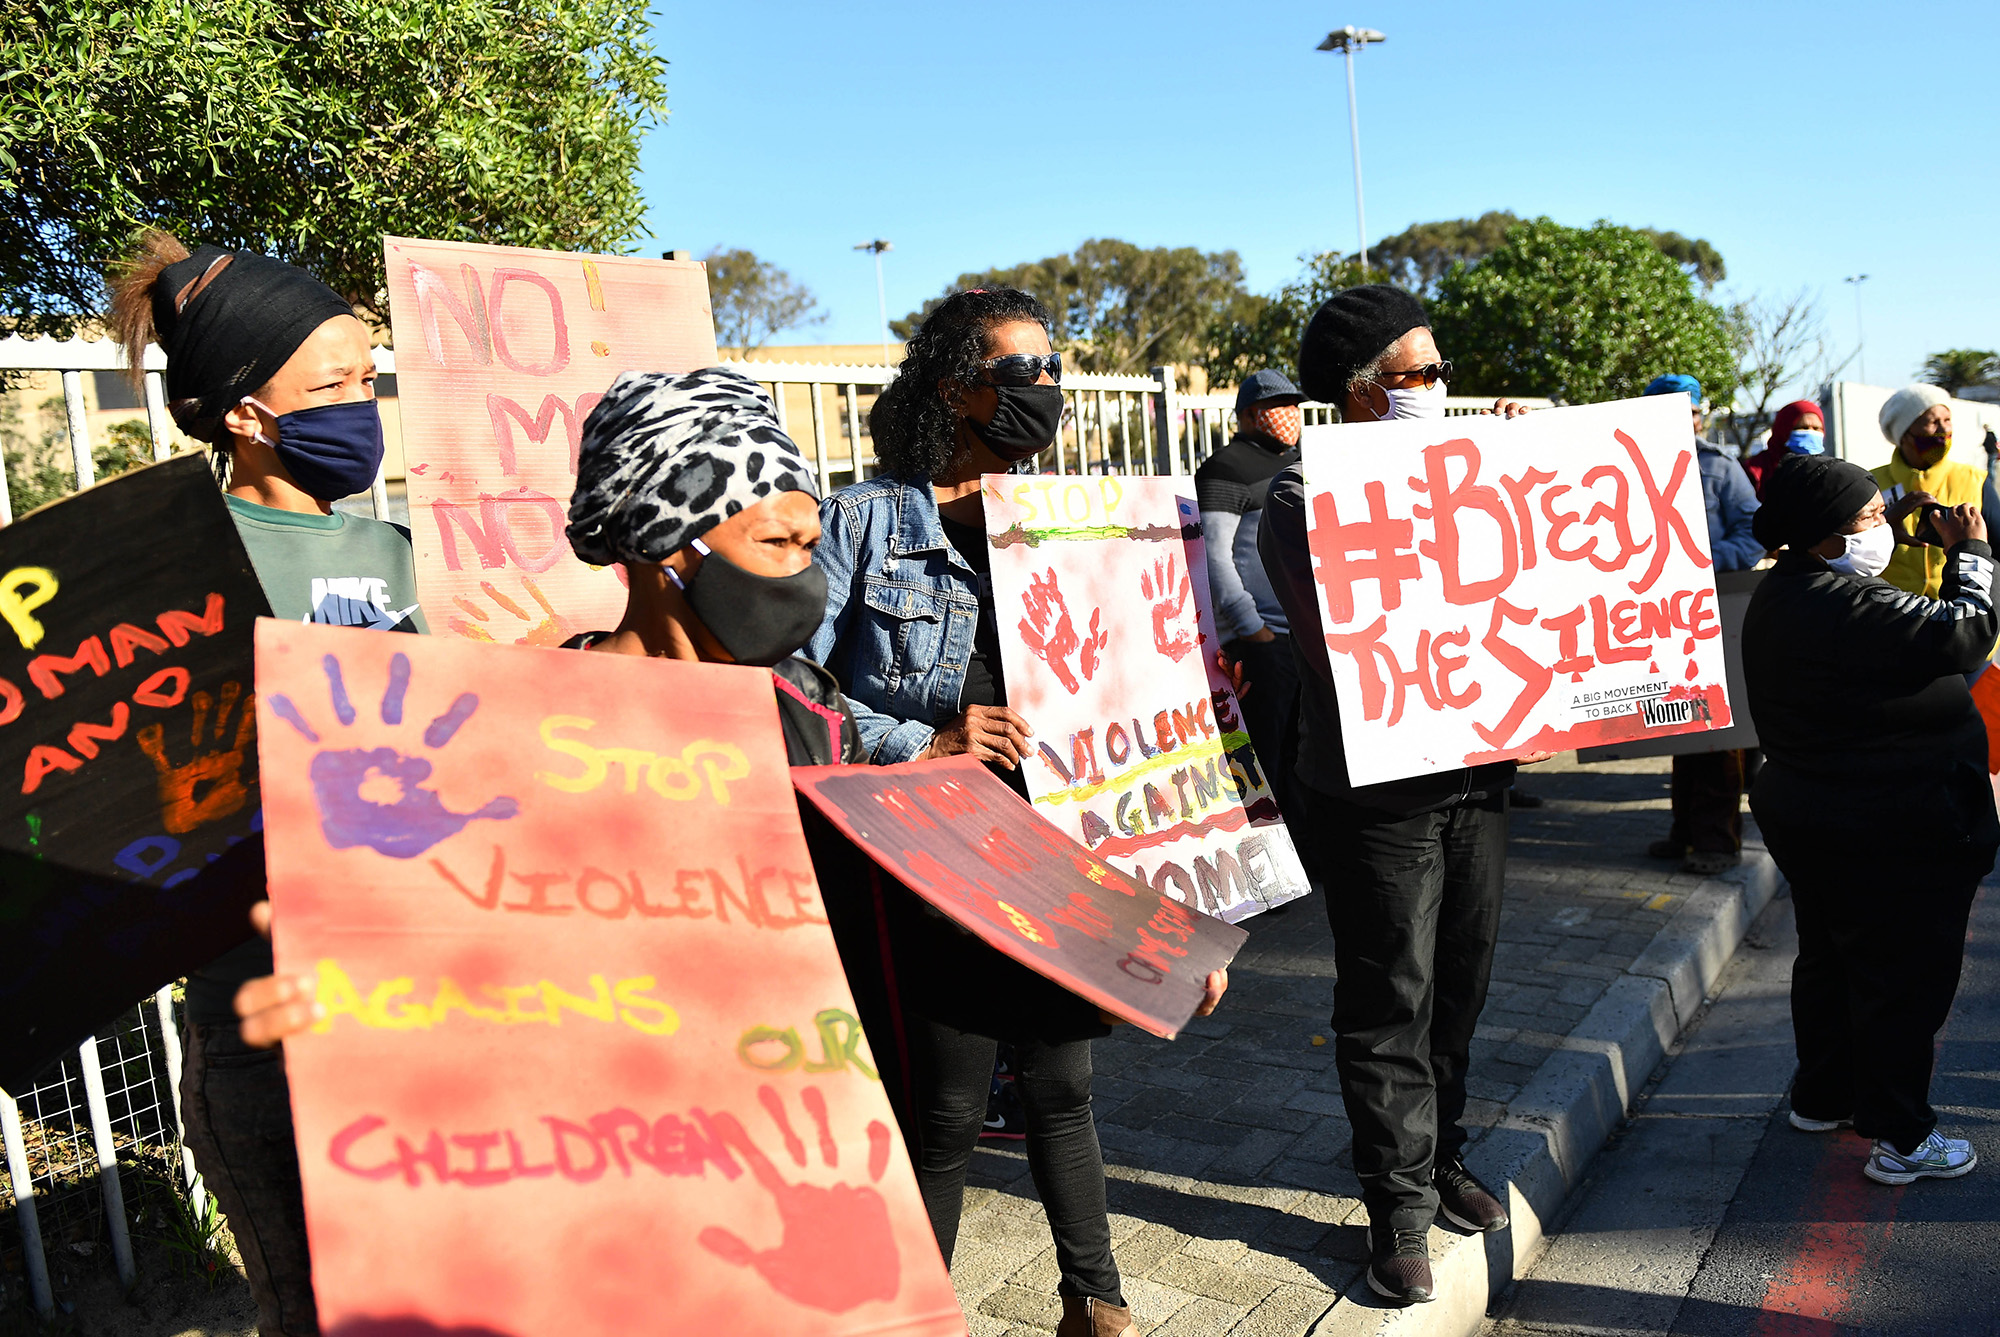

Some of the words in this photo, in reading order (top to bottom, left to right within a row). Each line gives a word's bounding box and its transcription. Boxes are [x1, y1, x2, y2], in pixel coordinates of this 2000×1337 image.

[1012, 475, 1123, 524] STOP
[1326, 614, 1482, 727] THE
[1481, 588, 1721, 750] SILENCE
[1573, 695, 1581, 705] A
[1584, 691, 1601, 703] BIG
[1604, 681, 1669, 700] MOVEMENT
[21, 667, 191, 795] AND
[1037, 688, 1240, 788] VIOLENCE
[1585, 708, 1600, 719] TO
[1603, 703, 1633, 716] BACK
[1079, 743, 1264, 849] AGAINST
[429, 845, 829, 930] VIOLENCE
[311, 959, 680, 1036] AGAINS
[328, 1107, 745, 1188] CHILDREN
